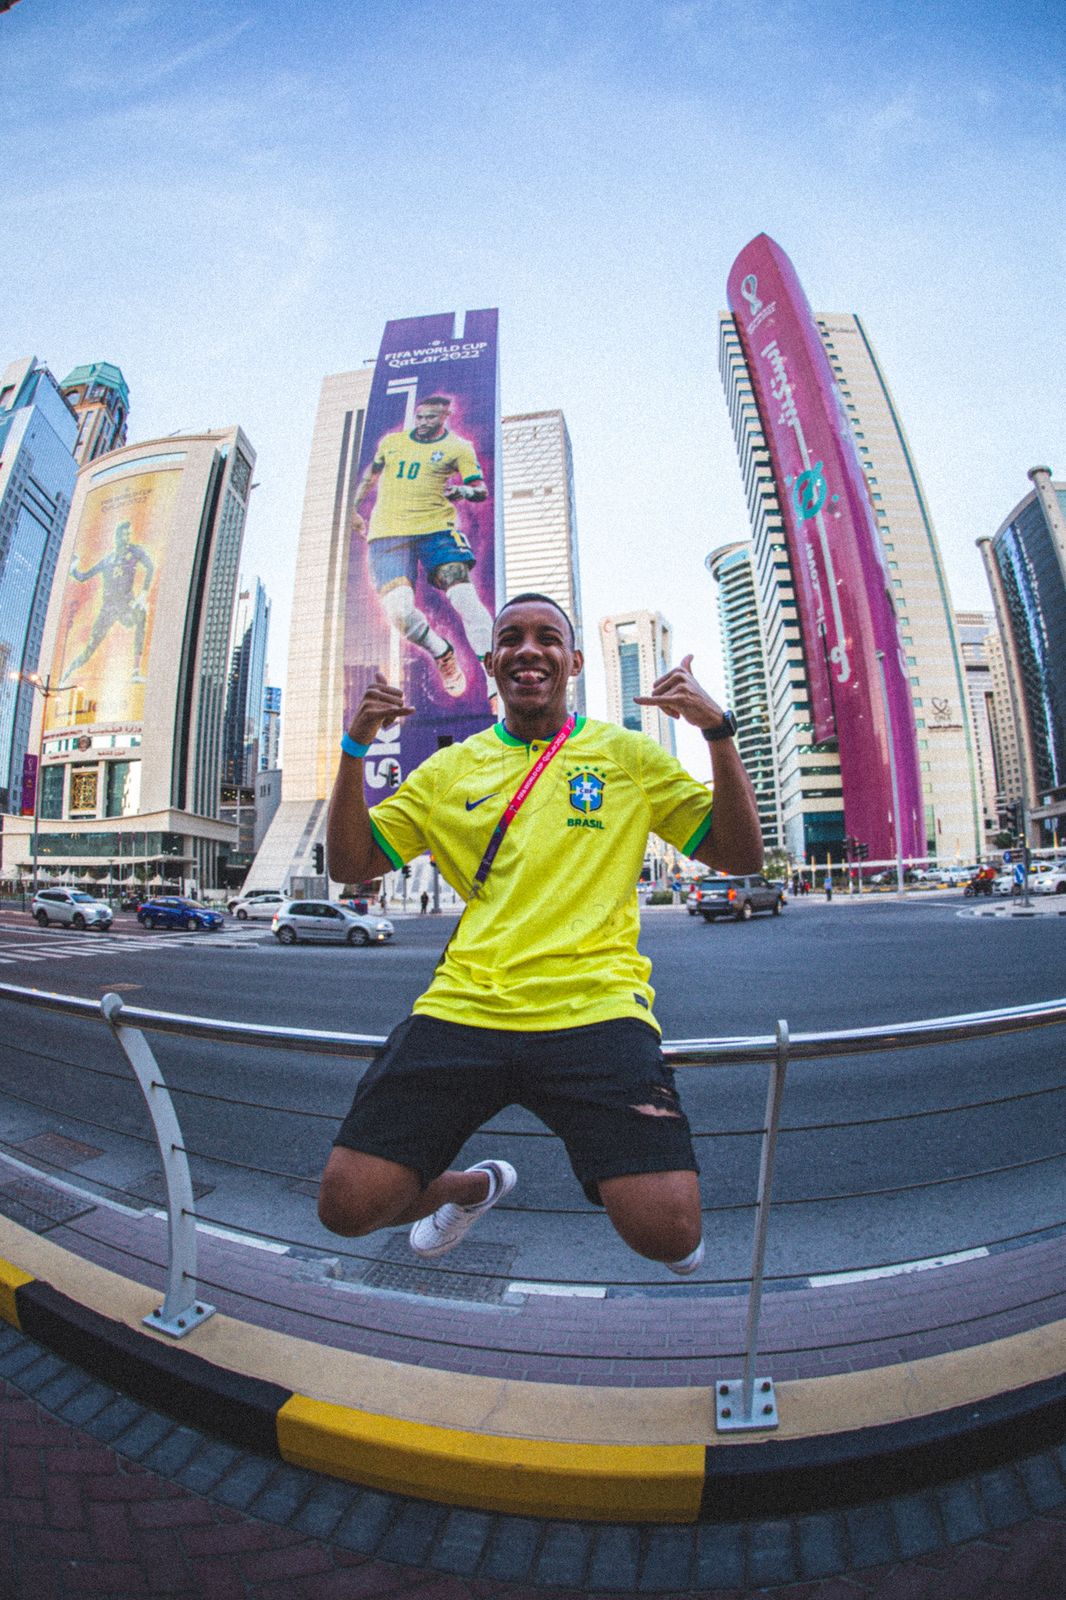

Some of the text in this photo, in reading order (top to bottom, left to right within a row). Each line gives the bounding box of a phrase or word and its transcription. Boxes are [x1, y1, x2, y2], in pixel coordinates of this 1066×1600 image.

[385, 342, 488, 361] FIFA WORLD CUP
[396, 459, 421, 480] 10
[567, 818, 605, 830] BRASIL
